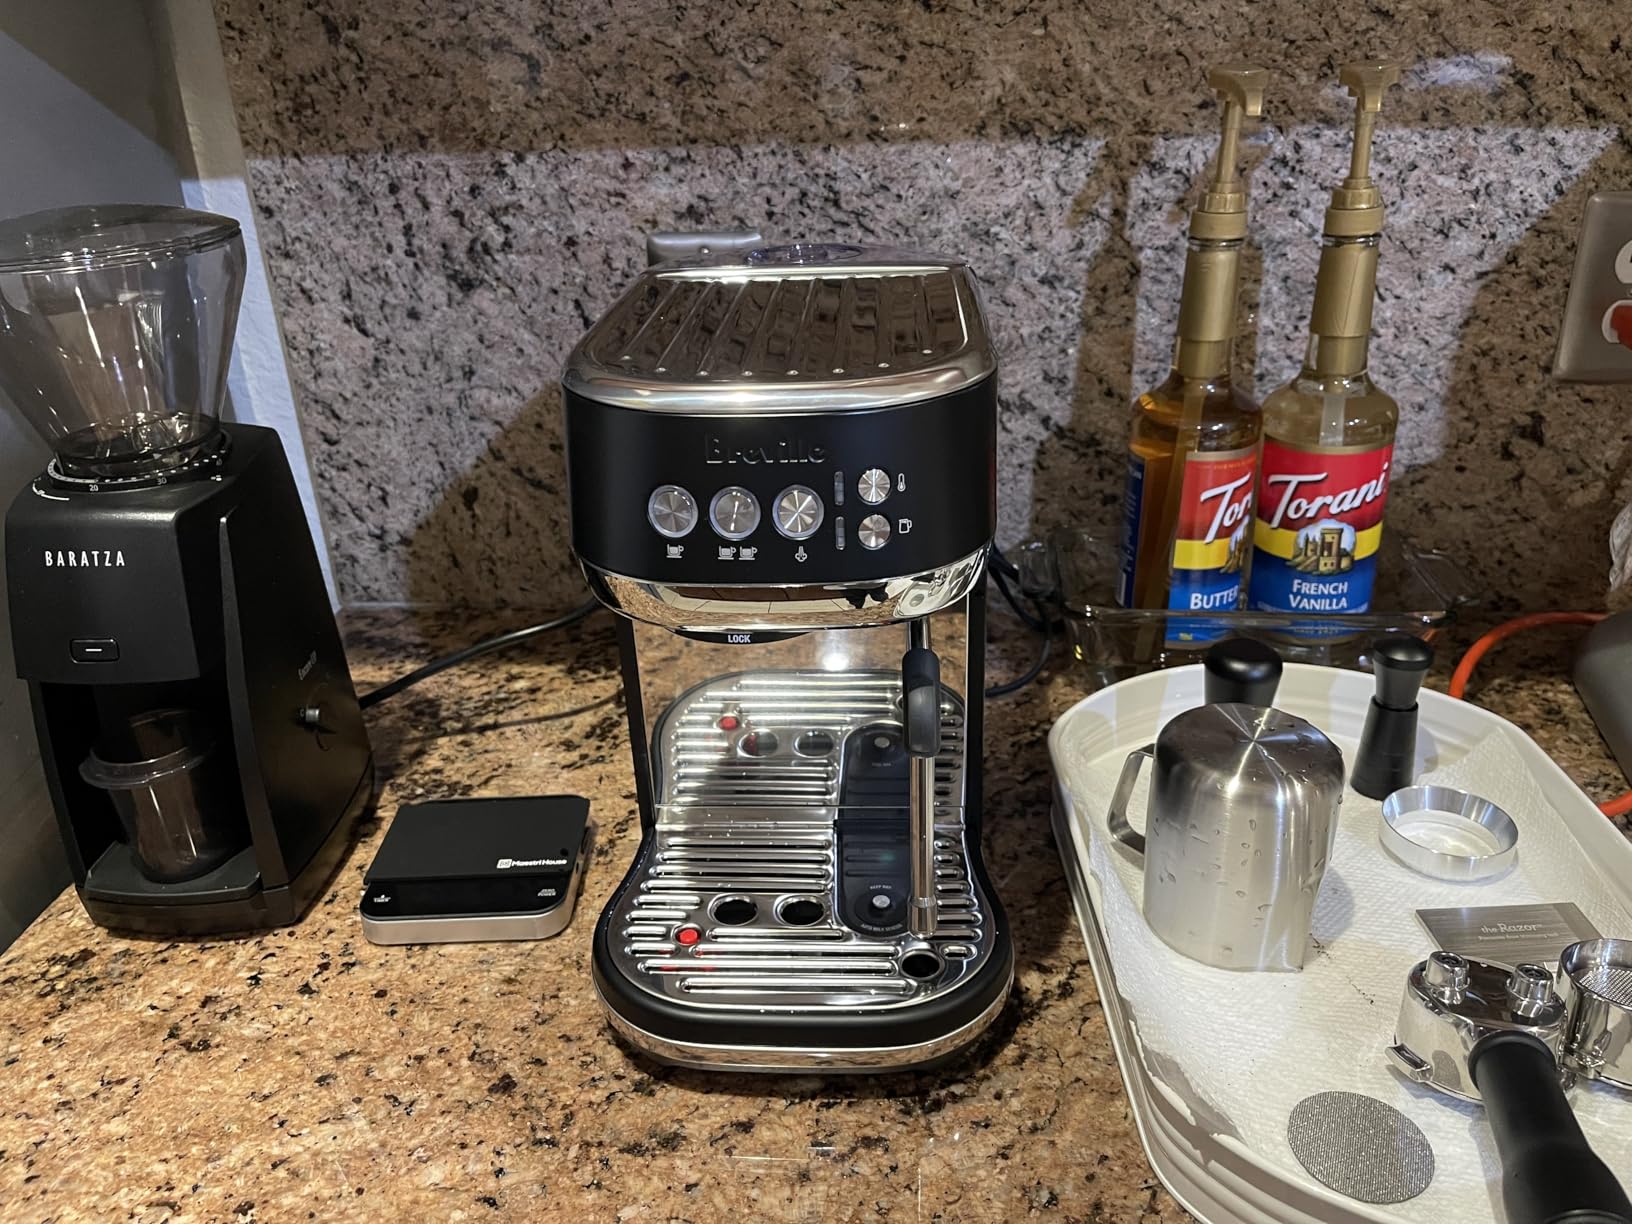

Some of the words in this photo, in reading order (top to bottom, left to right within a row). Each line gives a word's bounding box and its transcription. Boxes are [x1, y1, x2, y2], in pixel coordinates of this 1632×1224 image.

[704, 434, 825, 465] Breville
[157, 477, 167, 486] 30
[89, 484, 99, 492] 20
[1268, 461, 1389, 529] Torani
[44, 550, 126, 567] BARATZA
[1292, 578, 1348, 595] FRENCH
[1289, 594, 1348, 610] VANILLA
[727, 634, 751, 643] LOCK
[511, 859, 541, 867] Maestri
[542, 858, 568, 866] House
[1481, 925, 1498, 934] the
